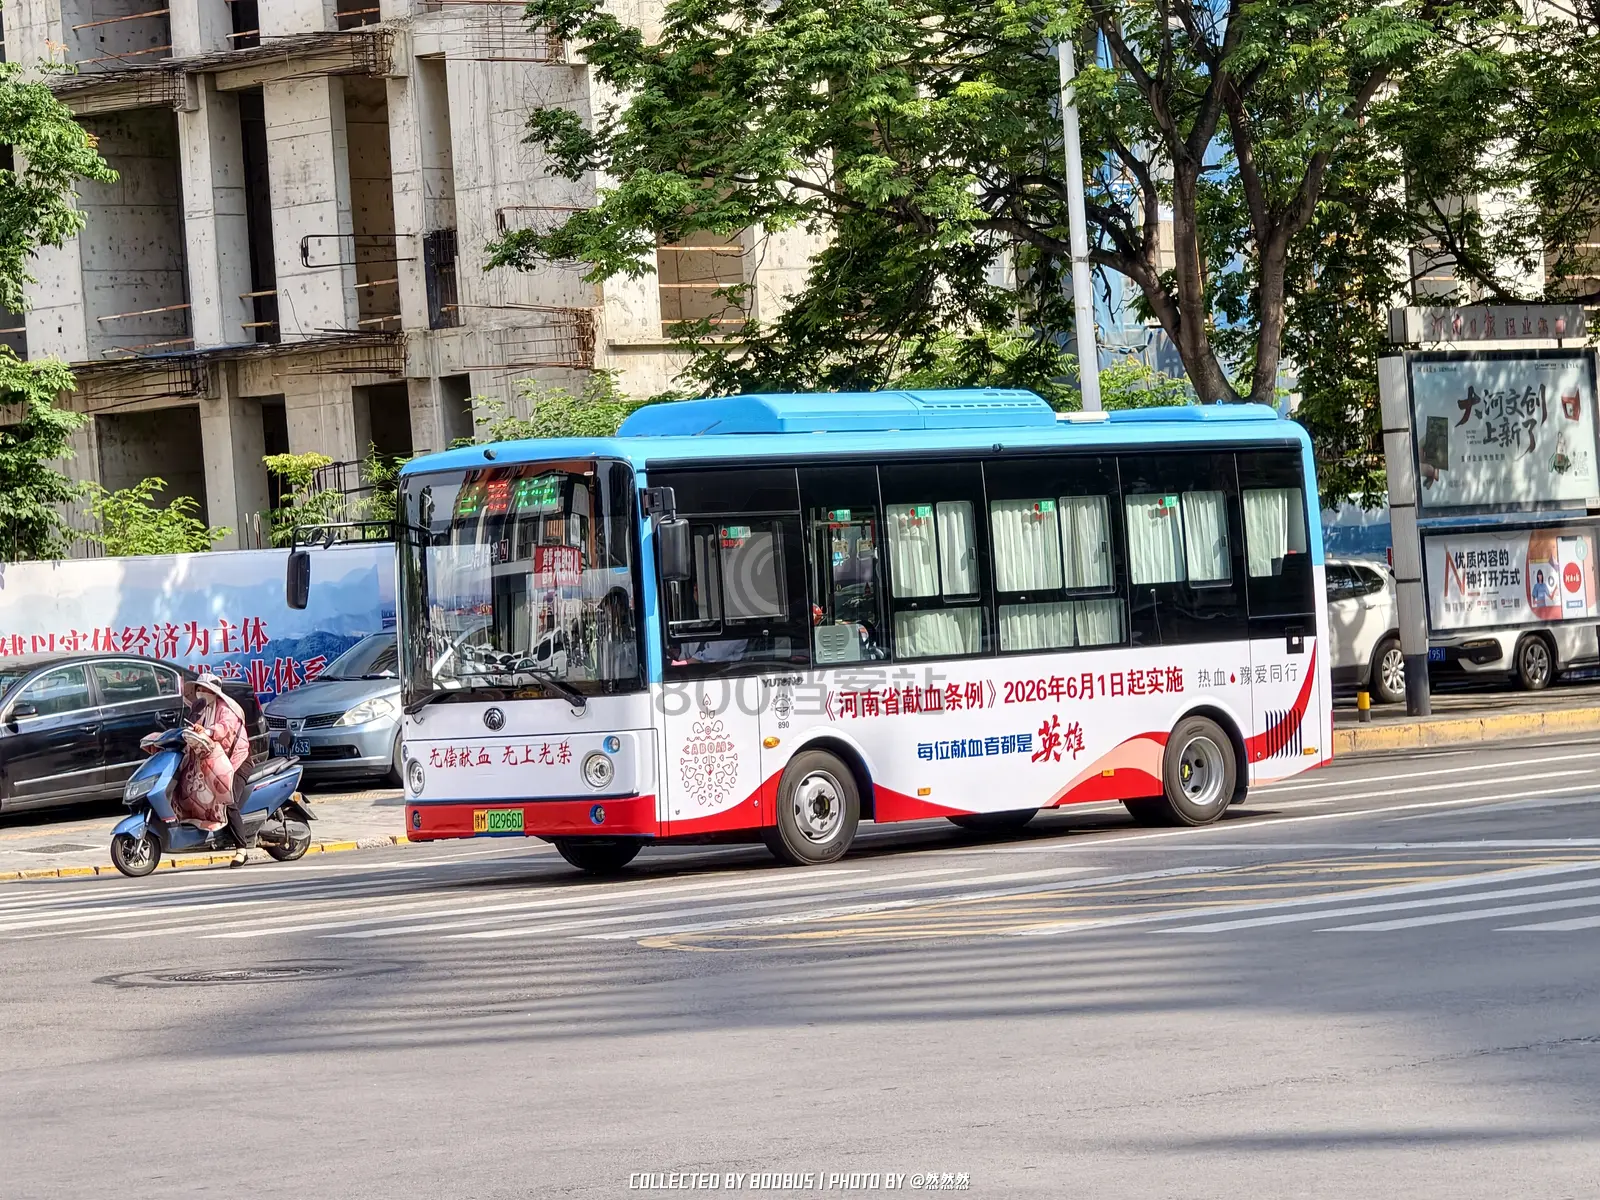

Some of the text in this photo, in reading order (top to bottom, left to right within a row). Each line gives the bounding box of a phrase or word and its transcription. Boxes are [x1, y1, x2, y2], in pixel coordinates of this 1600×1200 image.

[1455, 383, 1547, 427] 大河文创
[1482, 417, 1538, 461] 上新了
[1455, 548, 1510, 570] 优质内容的
[1466, 568, 1521, 590] 种打开方式
[1198, 663, 1298, 688] 热血 豫爱同行
[778, 721, 790, 729] 890
[429, 742, 573, 769] 无偿献血 无上光荣
